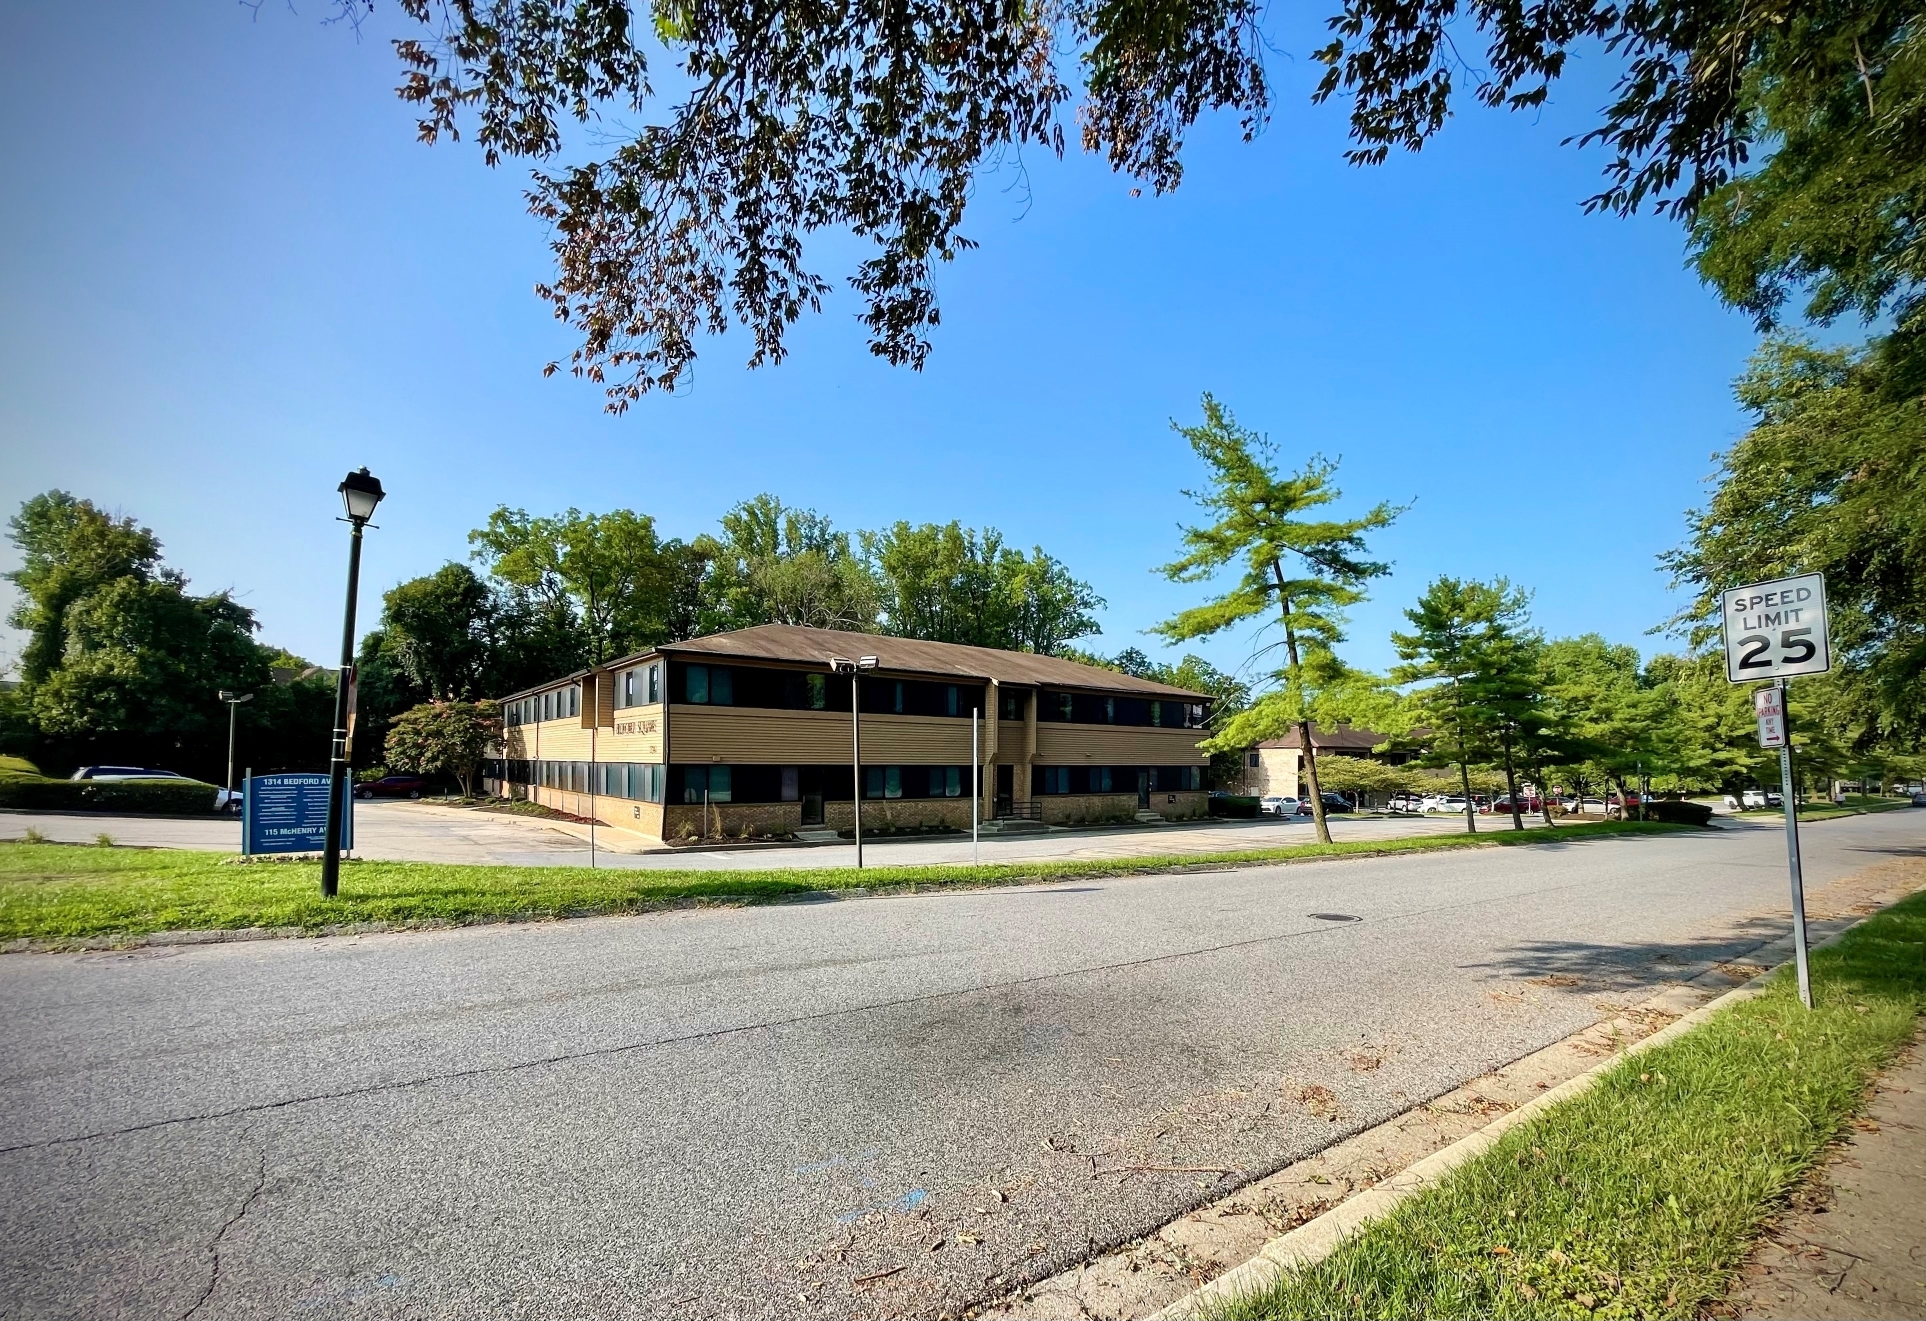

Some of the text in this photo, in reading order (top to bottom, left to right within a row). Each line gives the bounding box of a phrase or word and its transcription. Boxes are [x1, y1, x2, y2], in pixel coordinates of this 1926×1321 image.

[1734, 587, 1812, 612] SPEED
[1742, 608, 1804, 631] LIMIT
[1737, 627, 1816, 670] 25
[1763, 692, 1773, 705] NO
[1758, 705, 1780, 717] PARKING
[264, 828, 278, 836] 115
[279, 827, 317, 835] McHENRY
